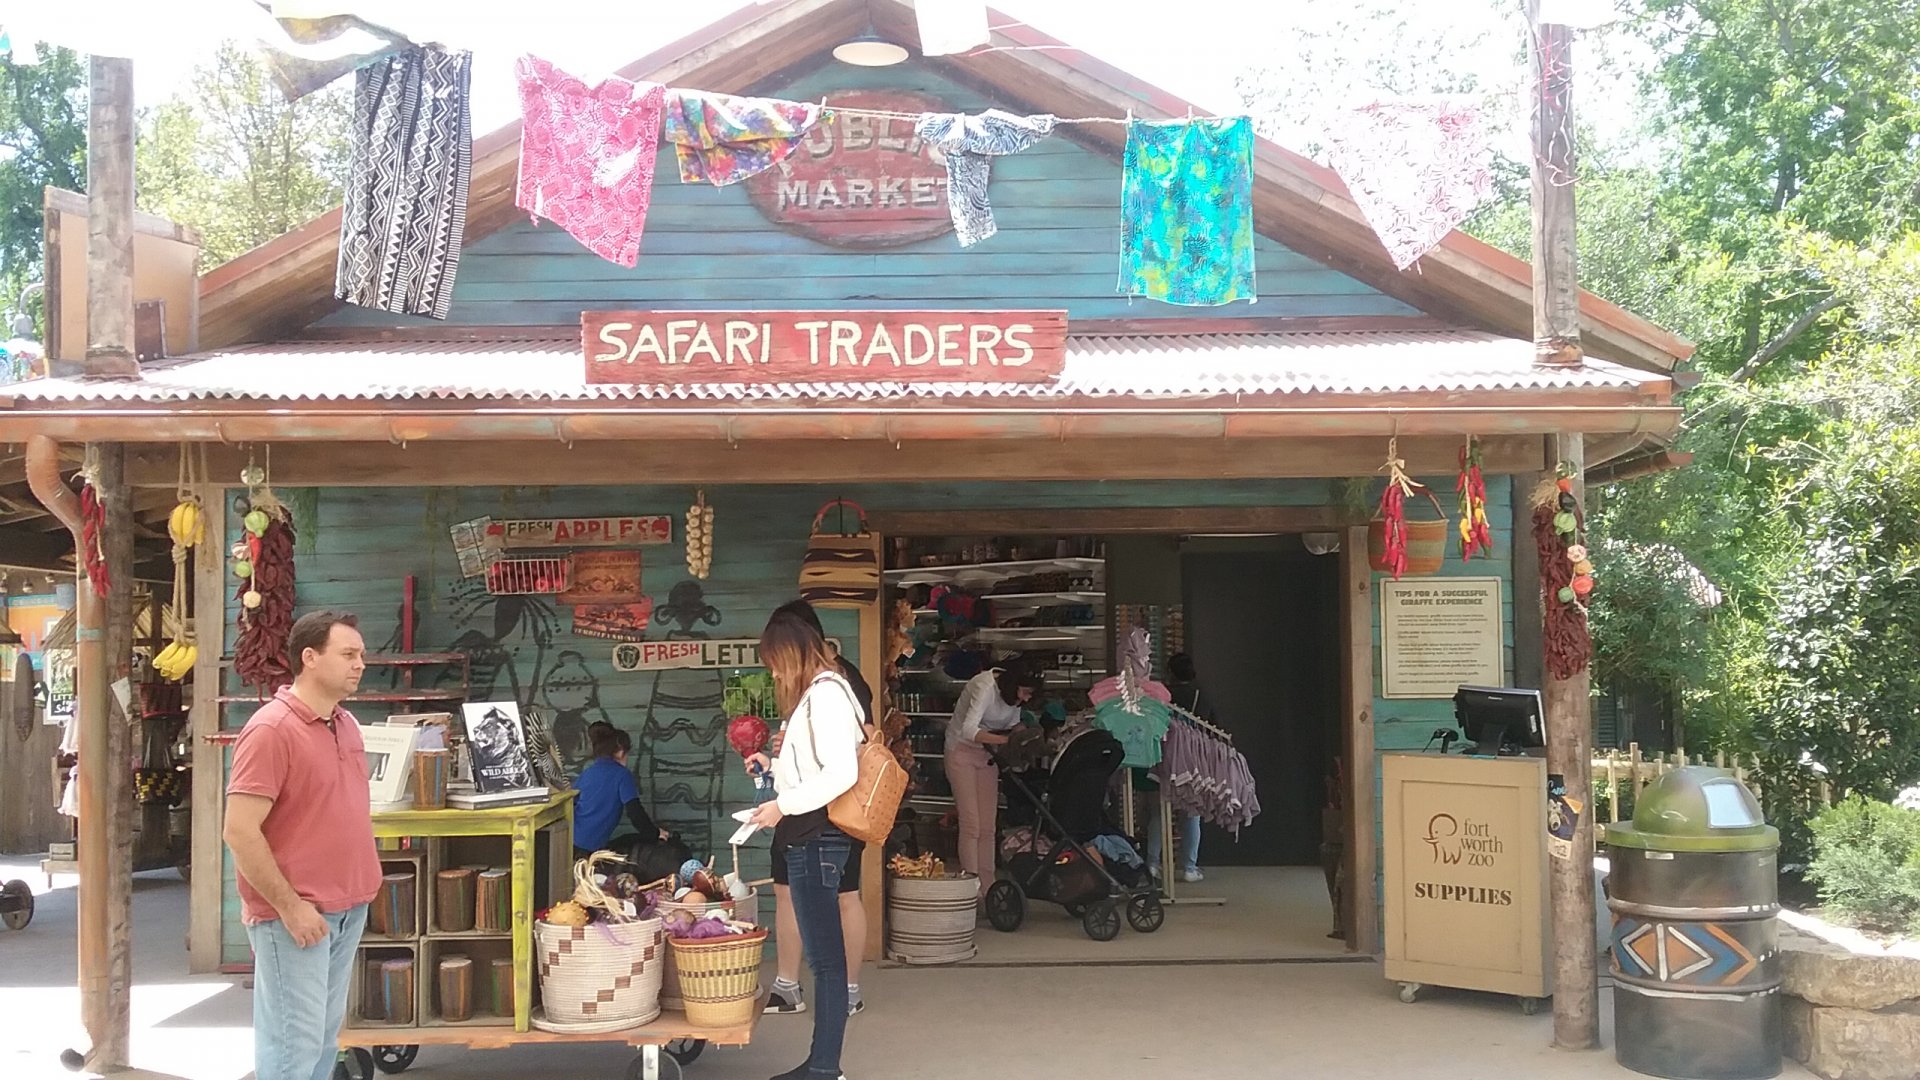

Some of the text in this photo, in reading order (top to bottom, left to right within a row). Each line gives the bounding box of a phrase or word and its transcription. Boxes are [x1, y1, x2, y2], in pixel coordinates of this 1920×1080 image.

[595, 319, 1034, 367] SAFARI TRADERS
[1400, 598, 1433, 606] GIRAFFE
[642, 642, 761, 666] FRESH LETT
[481, 768, 501, 777] WILD
[1463, 818, 1489, 837] fort
[1460, 836, 1503, 854] worth
[1468, 854, 1495, 867] zoo
[1414, 882, 1512, 906] SUPPLIES
